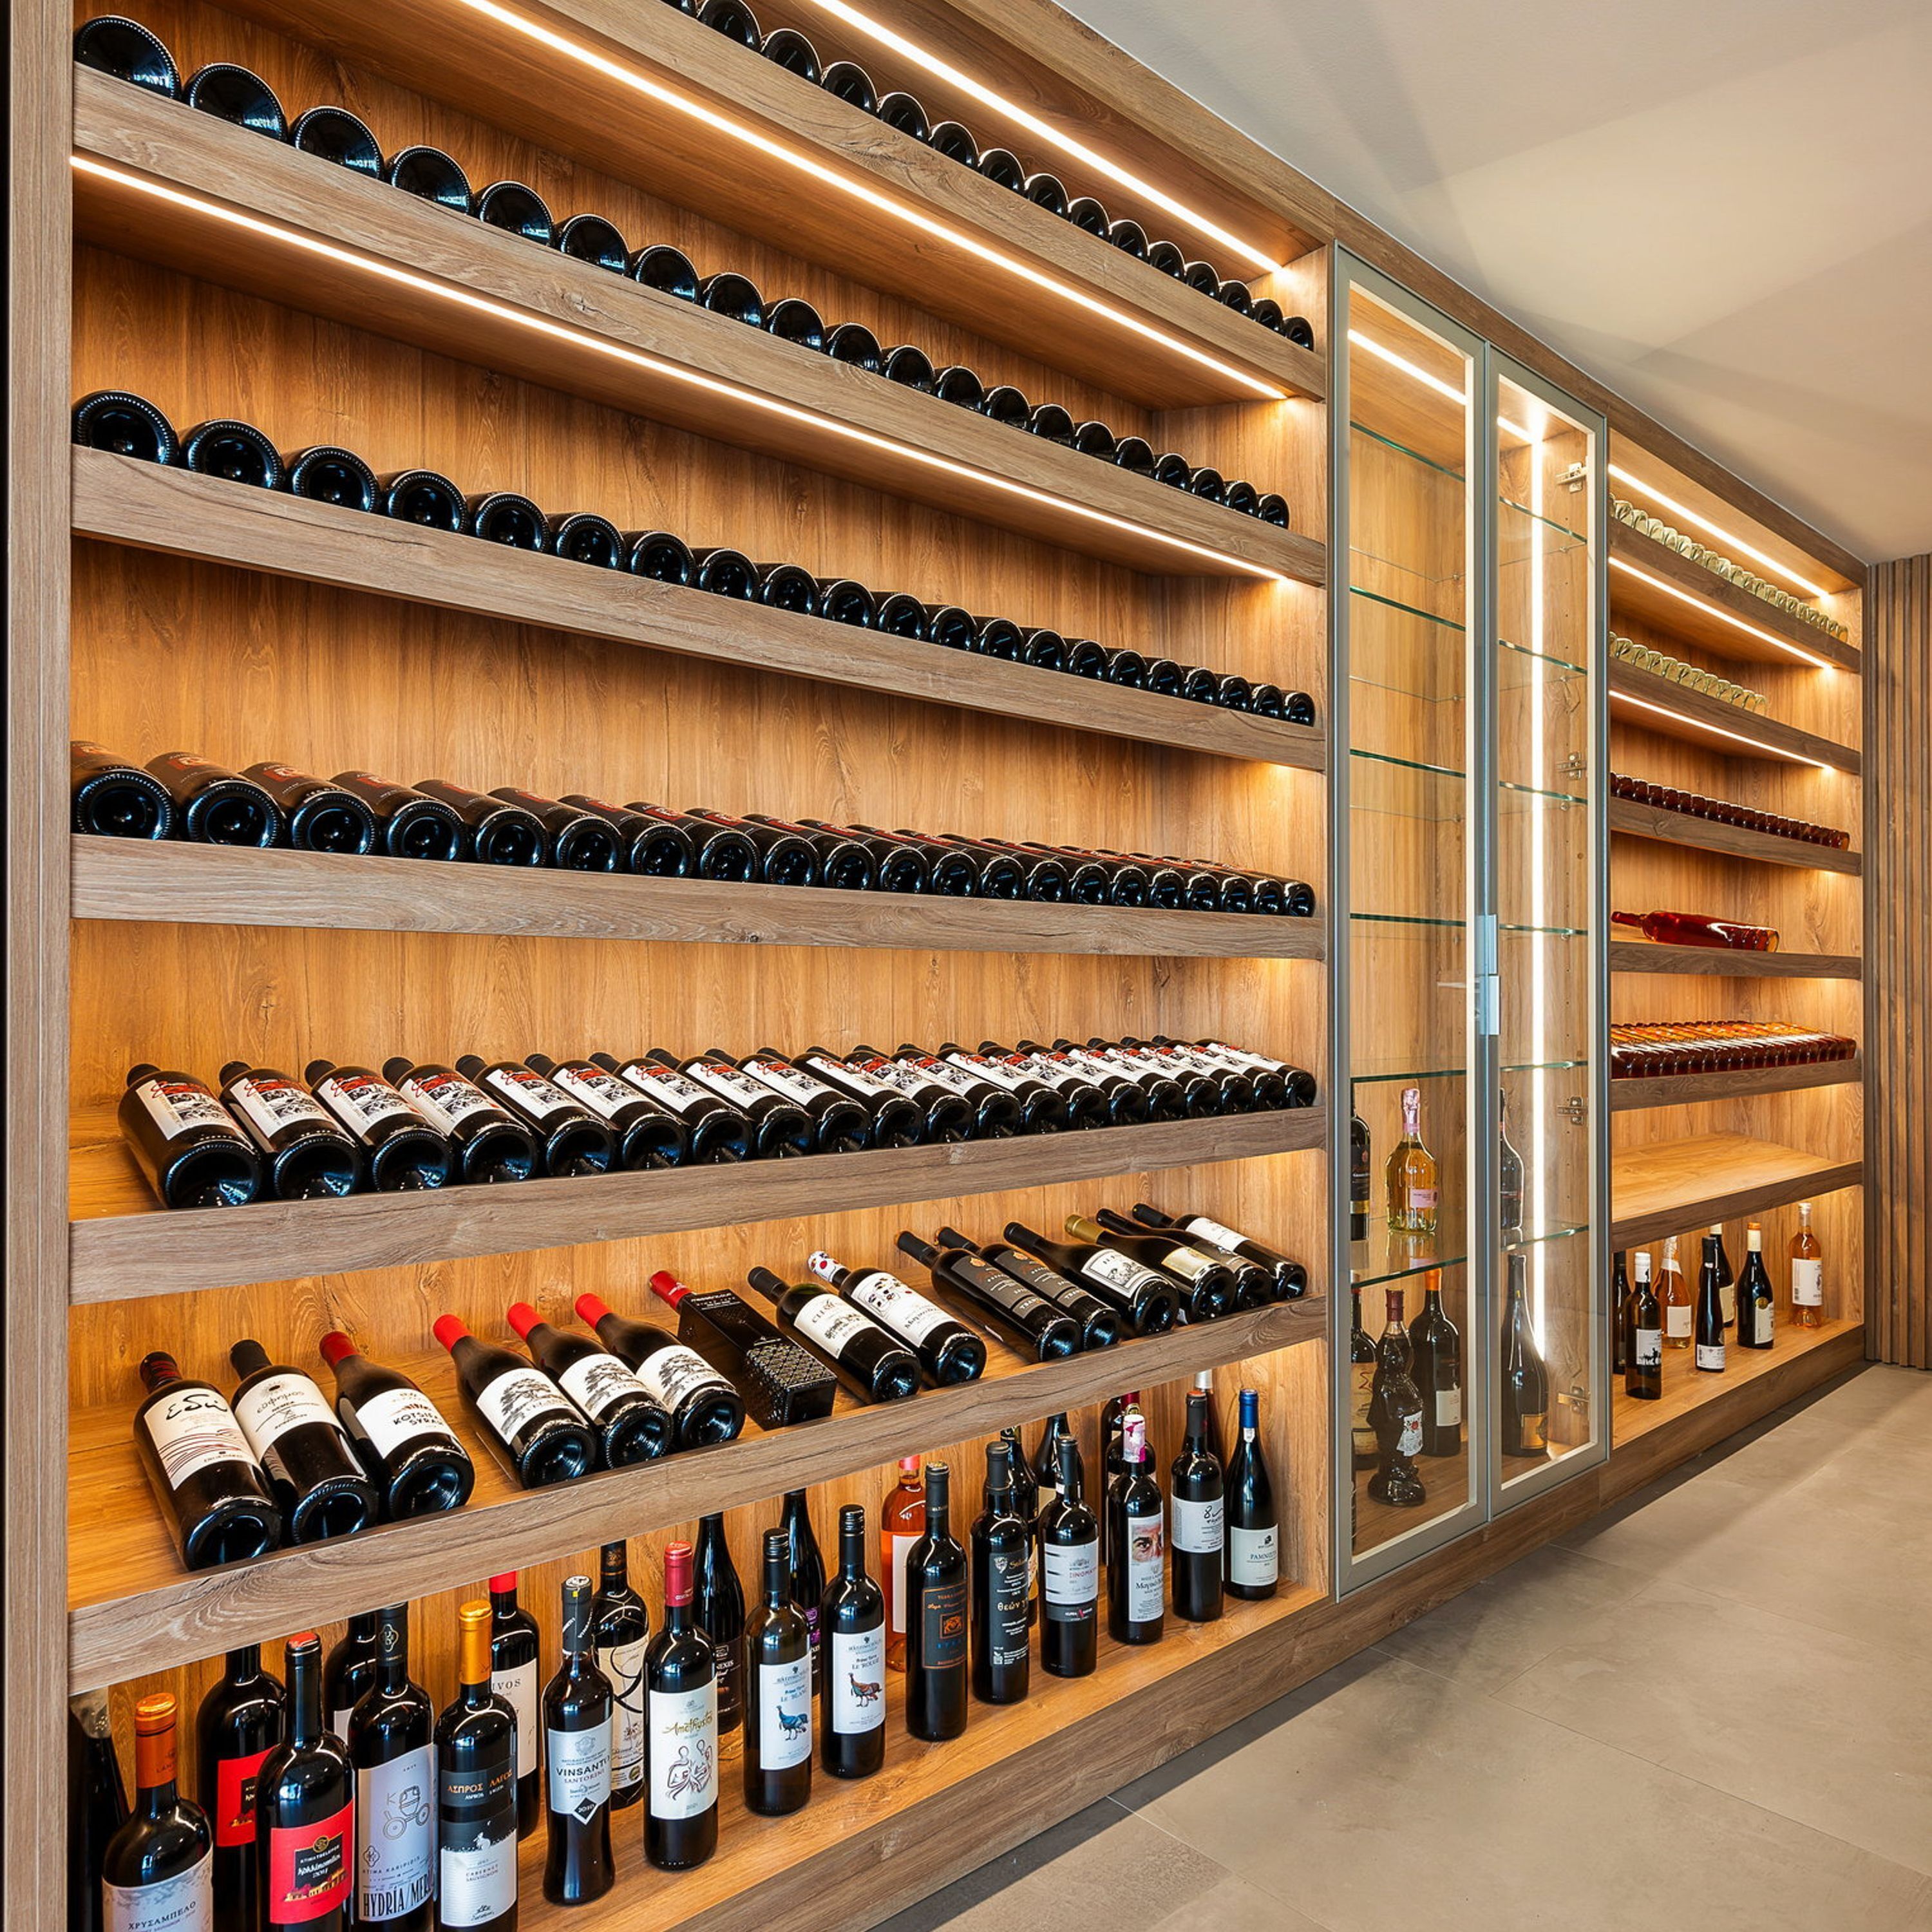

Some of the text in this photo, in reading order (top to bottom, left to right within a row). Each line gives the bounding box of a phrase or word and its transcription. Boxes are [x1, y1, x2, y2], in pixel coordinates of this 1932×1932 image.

[556, 1755, 611, 1776] VINSANTO
[448, 1783, 484, 1794] ΑΣΠΡΟΣ
[129, 1901, 196, 1930] ΧΡΥΣΑΜΠΕΛΟ
